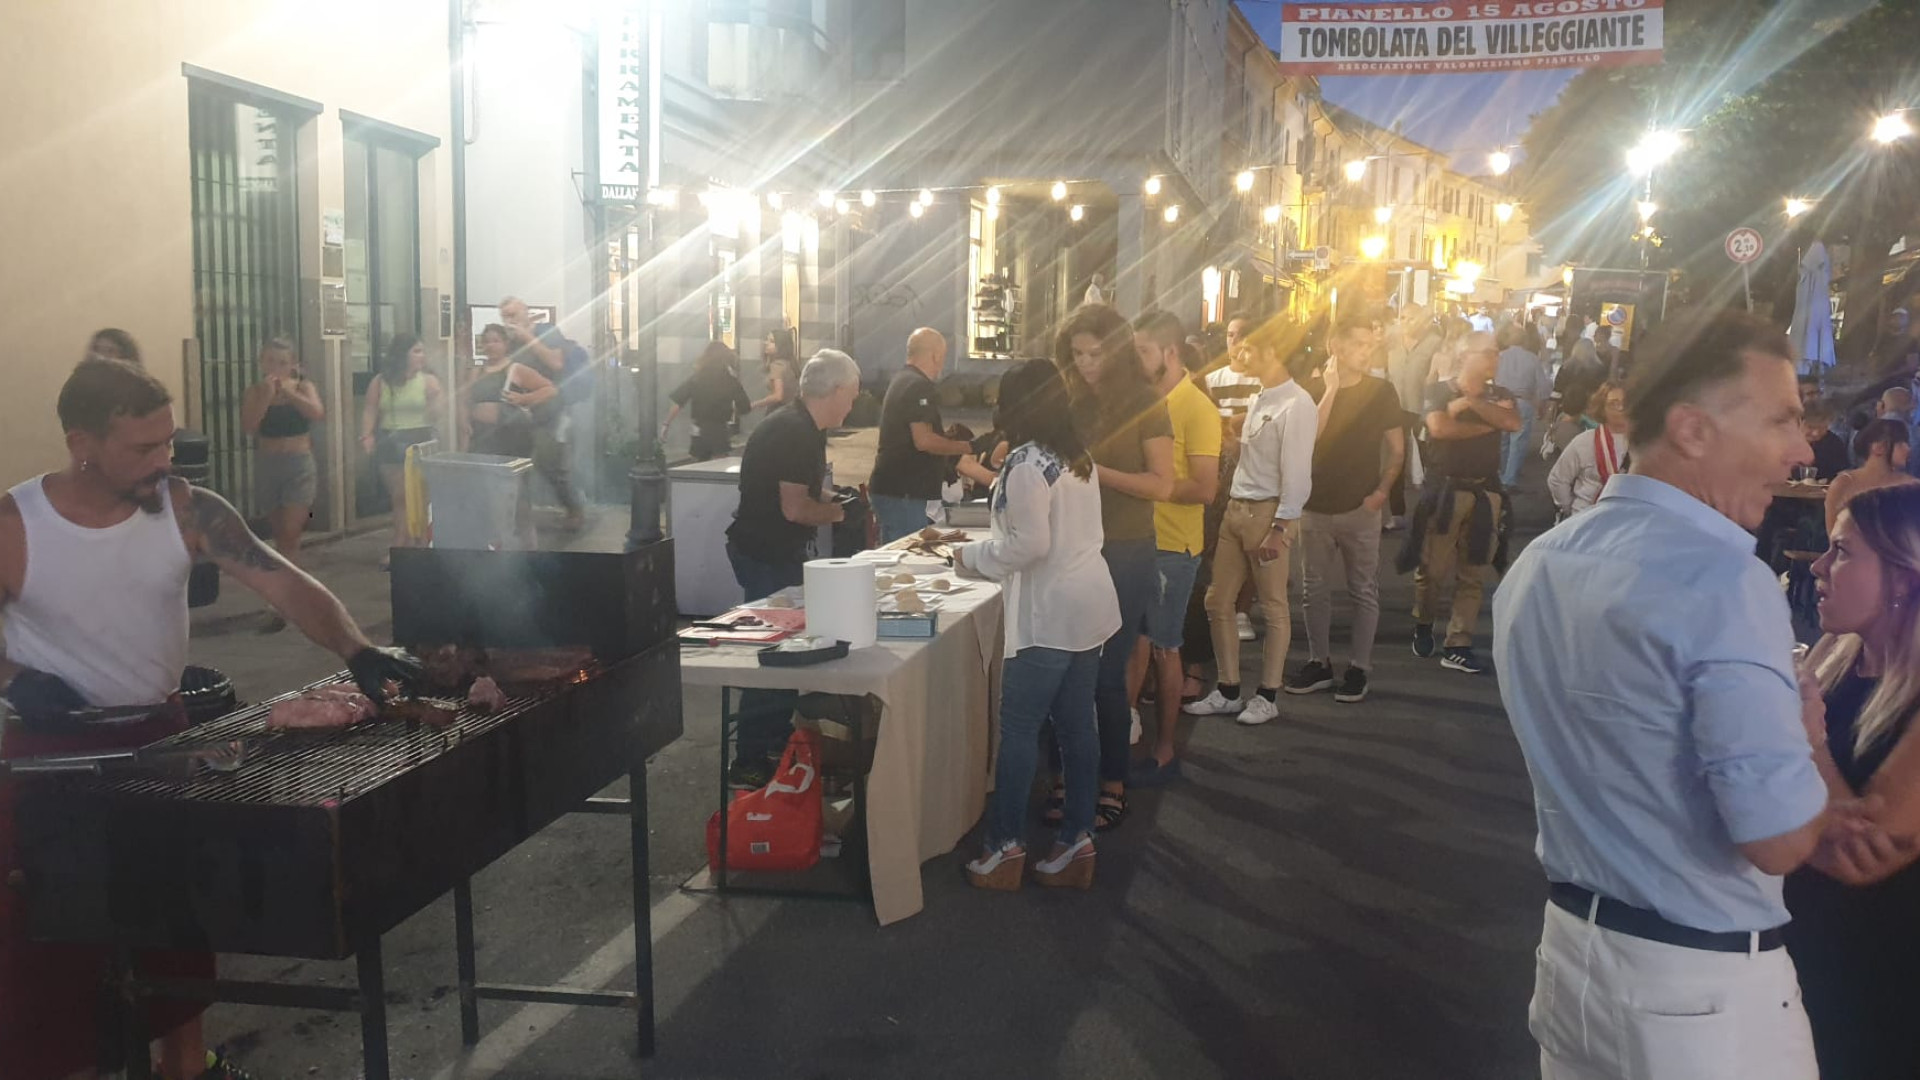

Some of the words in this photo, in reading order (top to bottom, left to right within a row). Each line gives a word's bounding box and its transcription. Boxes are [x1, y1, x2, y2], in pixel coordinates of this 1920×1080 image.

[1299, 6, 1454, 21] PIANELLO
[1467, 4, 1500, 18] 15
[1511, 0, 1644, 17] AGOSTO
[1298, 26, 1429, 58] TOMBOLATA
[1436, 25, 1476, 56] DEL
[1485, 14, 1645, 54] VILLEGGIANTE
[1337, 63, 1430, 71] ASSOCIAZIONE
[1537, 55, 1600, 65] PIANELLO
